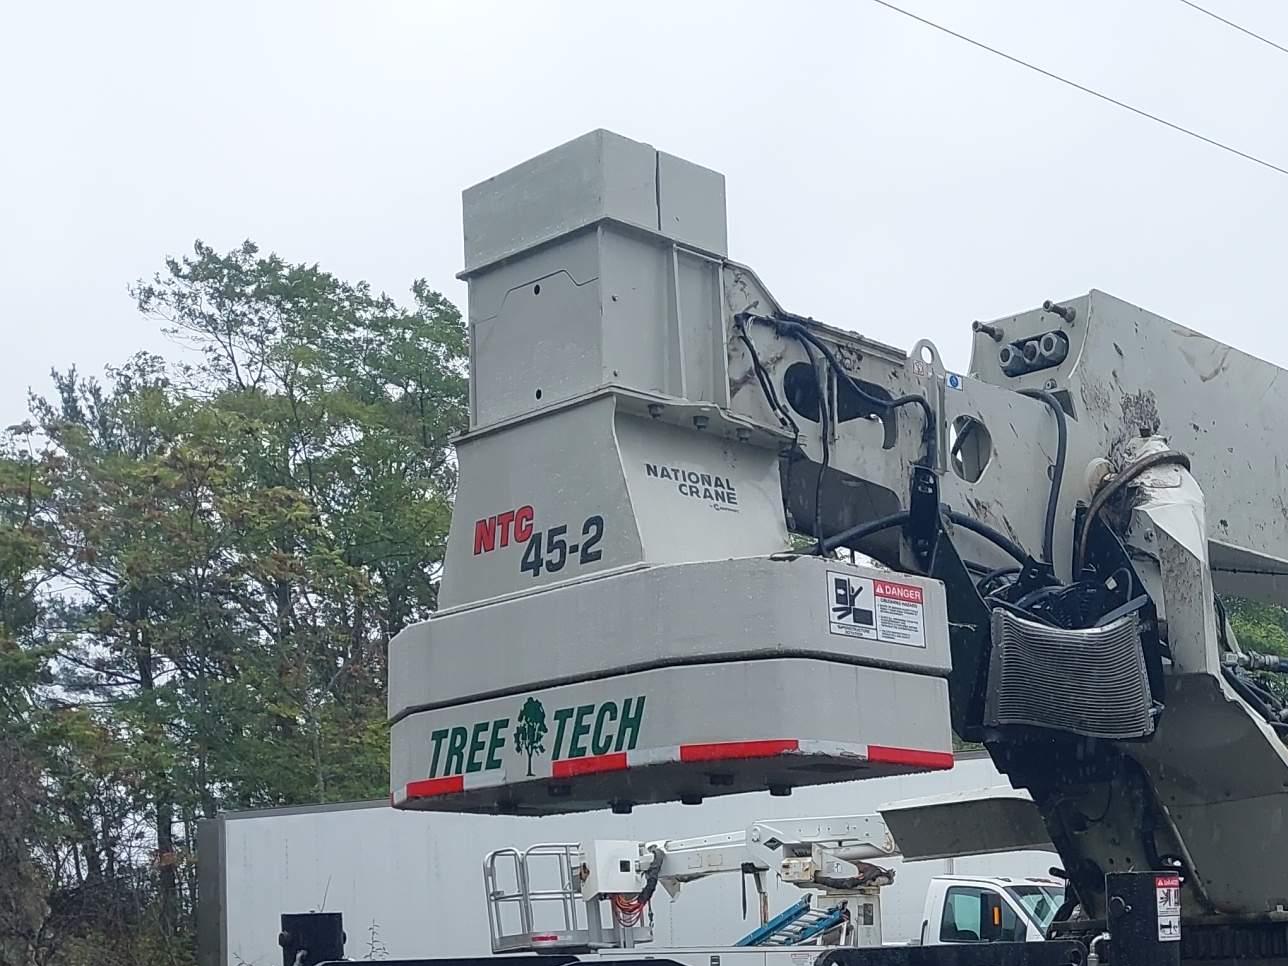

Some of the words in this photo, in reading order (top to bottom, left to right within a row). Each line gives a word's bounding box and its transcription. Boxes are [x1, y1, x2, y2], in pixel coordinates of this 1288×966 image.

[645, 463, 736, 492] NATIONAL
[678, 483, 738, 505] CRANE
[473, 504, 535, 556] NTC
[520, 515, 605, 578] 45-2
[885, 586, 921, 601] DANGER
[430, 718, 510, 779] TREE
[552, 695, 646, 760] TECH
